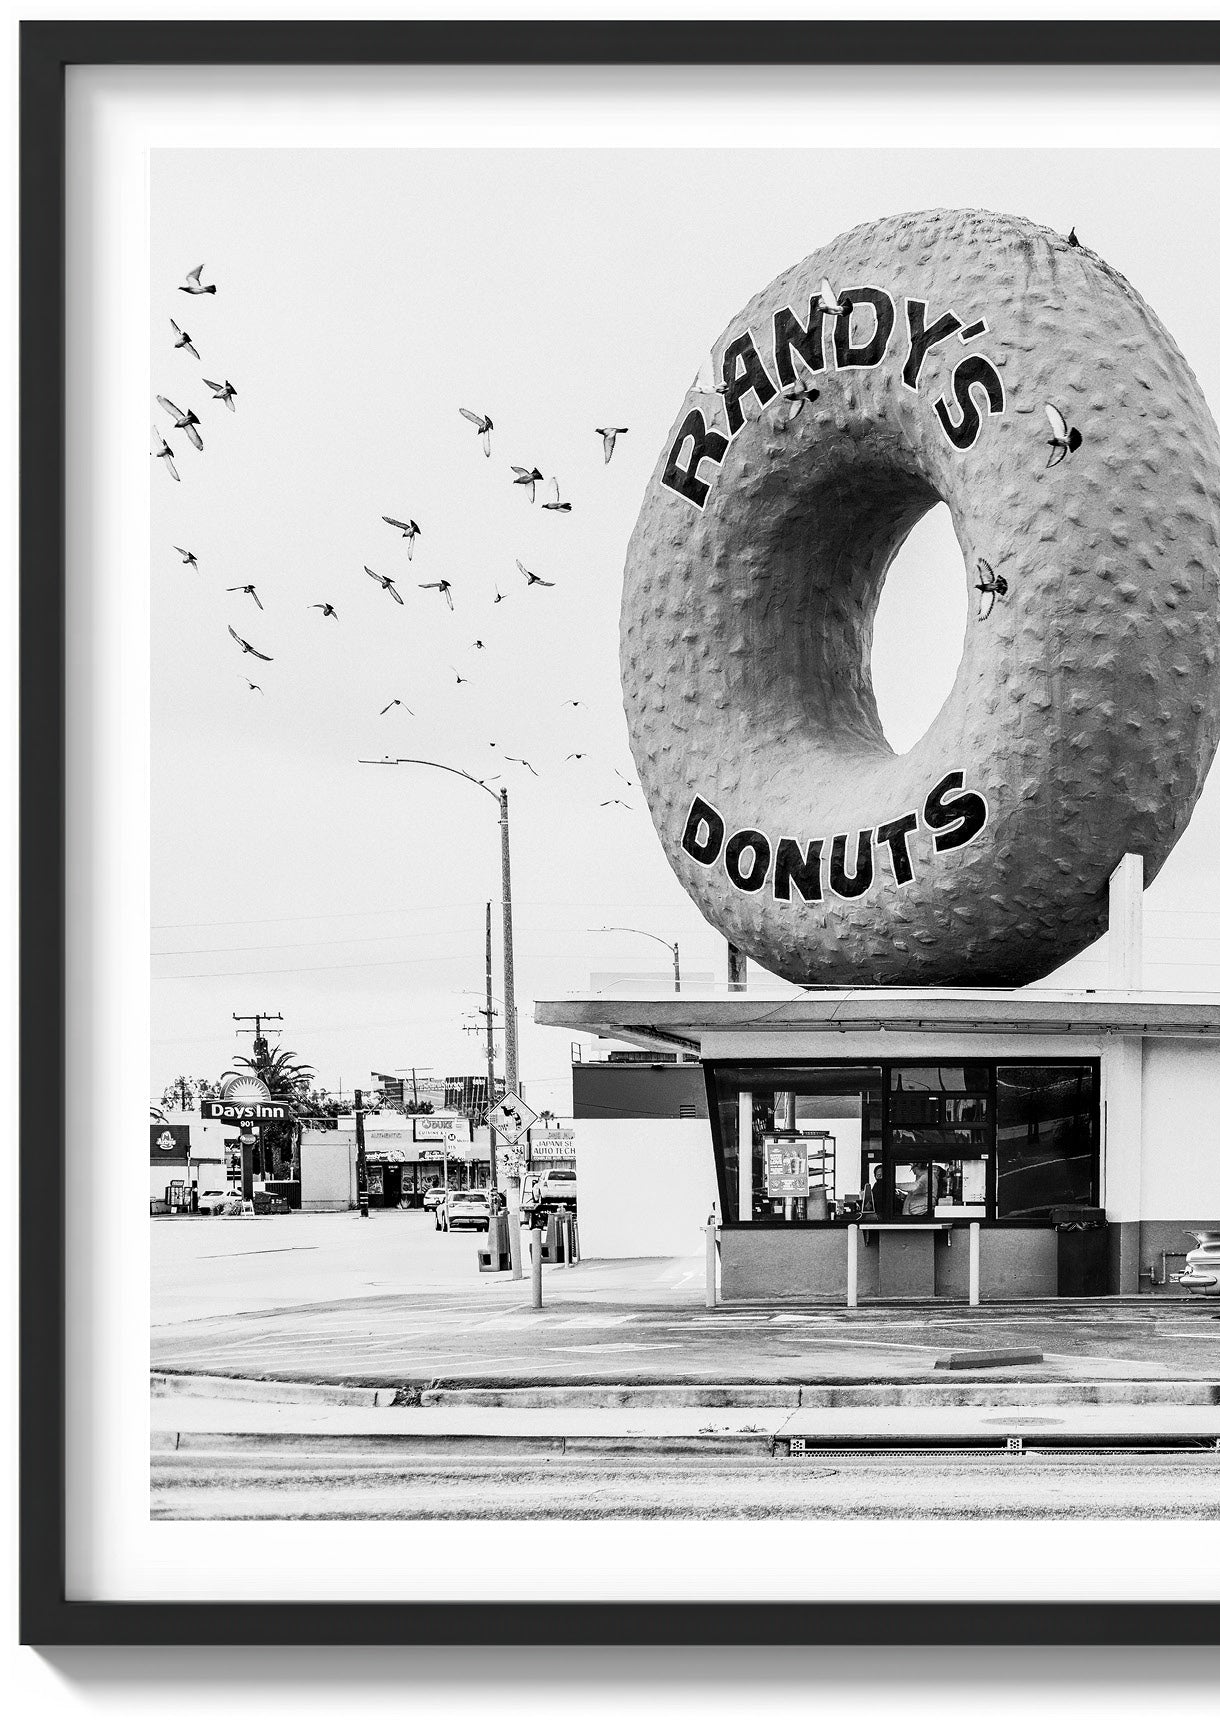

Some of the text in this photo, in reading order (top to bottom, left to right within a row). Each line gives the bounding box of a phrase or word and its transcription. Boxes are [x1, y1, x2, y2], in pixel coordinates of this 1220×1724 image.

[660, 285, 1006, 511] RANDY'S
[681, 769, 989, 903] DONUTS
[211, 1104, 285, 1119] Days Inn
